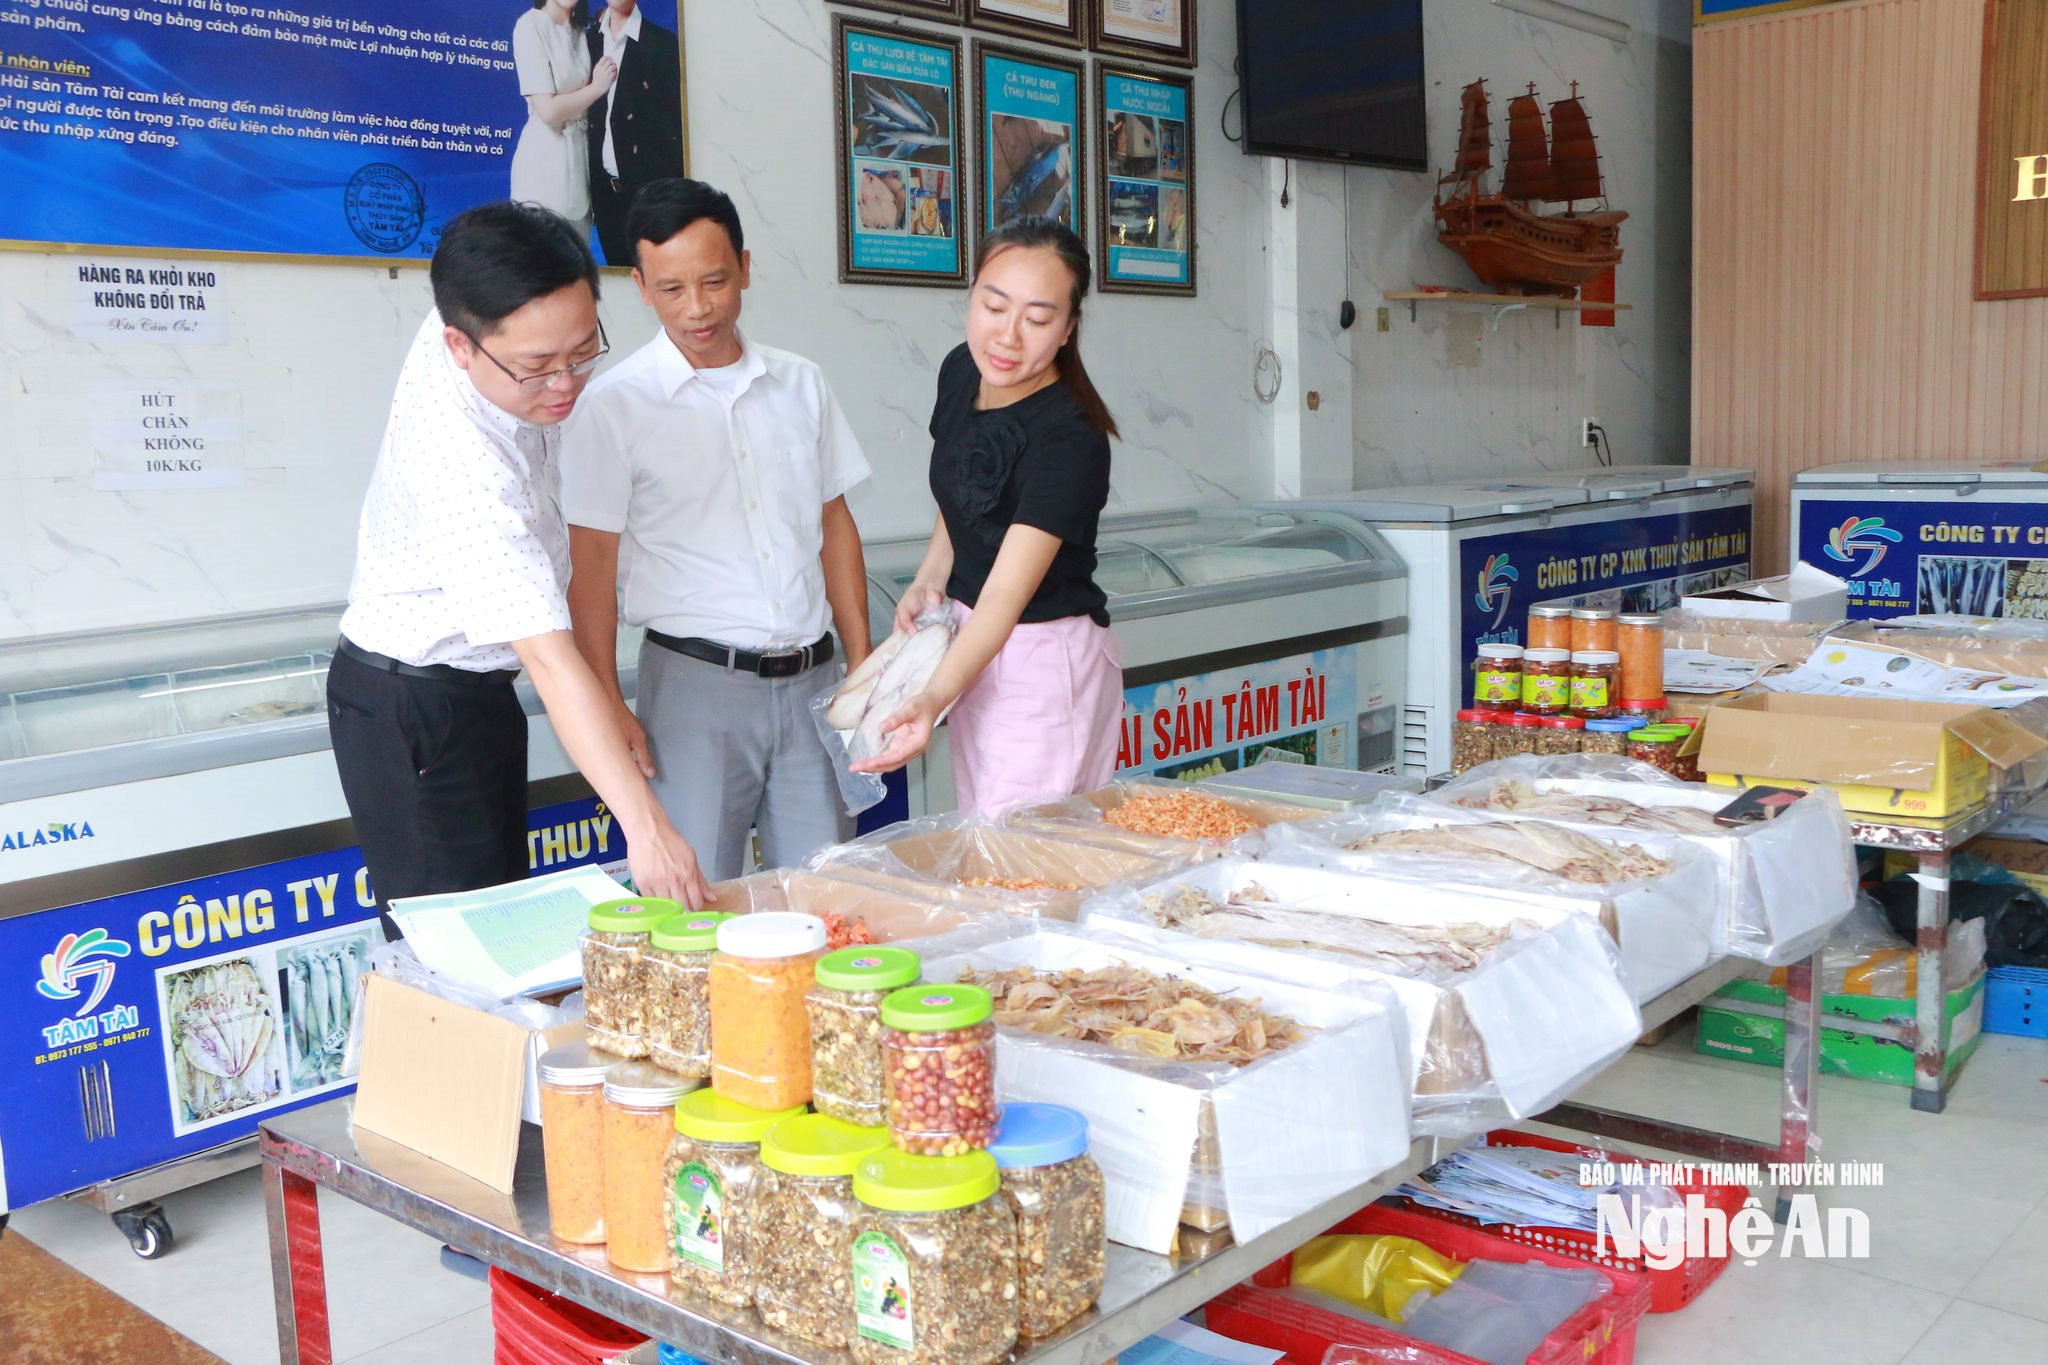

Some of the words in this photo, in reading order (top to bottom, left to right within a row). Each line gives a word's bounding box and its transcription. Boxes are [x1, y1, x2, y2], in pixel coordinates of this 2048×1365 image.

[0, 9, 30, 26] sản
[35, 16, 86, 33] phẩm.
[226, 2, 248, 17] tạo
[252, 8, 264, 18] ra
[268, 9, 309, 26] những
[312, 15, 332, 28] giá
[336, 18, 350, 33] trị
[352, 21, 374, 34] bền
[378, 24, 407, 40] vững
[410, 30, 432, 42] cho
[434, 32, 451, 44] tất
[453, 34, 466, 46] cả
[469, 38, 489, 50] các
[491, 40, 508, 52] đối
[92, 5, 130, 20] cung
[134, 8, 162, 26] ứng
[166, 12, 202, 31] bằng
[206, 22, 238, 34] cách
[242, 24, 272, 38] đảm
[275, 29, 299, 42] bảo
[302, 33, 328, 48] một
[330, 38, 357, 50] mức
[360, 40, 378, 55] Lợi
[380, 42, 418, 59] nhuận
[422, 50, 443, 62] hợp
[446, 51, 456, 64] lý
[458, 54, 490, 69] thông
[493, 60, 514, 70] qua
[8, 54, 50, 70] nhân
[1, 74, 28, 90] Hải
[32, 77, 61, 92] sản
[65, 80, 98, 97] Tâm
[102, 85, 124, 100] Tài
[127, 90, 158, 104] cam
[162, 92, 186, 106] kết
[188, 98, 228, 113] mang
[232, 99, 256, 114] đến
[260, 104, 284, 116] môi
[287, 105, 329, 123] trường
[332, 110, 356, 124] làm
[359, 114, 382, 126] việc
[385, 116, 407, 128] hòa
[410, 118, 440, 134] đồng
[442, 122, 472, 136] tuyệt
[474, 126, 492, 138] vời,
[494, 128, 512, 138] nơi
[16, 98, 62, 114] người
[65, 103, 103, 120] được
[106, 107, 130, 121] tôn
[134, 110, 174, 126] trọng
[208, 117, 237, 131] điều
[240, 120, 268, 136] kiện
[271, 124, 294, 136] cho
[298, 126, 330, 140] nhân
[333, 129, 358, 142] viên
[361, 131, 388, 146] phát
[392, 134, 418, 148] triển
[422, 138, 443, 150] bản
[446, 140, 472, 153] thân
[475, 143, 488, 154] và
[490, 144, 504, 155] có
[23, 119, 50, 134] thu
[54, 124, 94, 140] nhập
[98, 127, 135, 144] xứng
[138, 131, 180, 148] đáng.
[79, 264, 120, 284] HÀNG
[126, 268, 145, 284] RA
[149, 265, 182, 286] KHỎI
[187, 271, 216, 288] KHO
[94, 289, 146, 309] KHÔNG
[150, 288, 175, 310] ĐỔI
[178, 290, 206, 311] TRẢ
[142, 391, 176, 407] HÚT
[142, 412, 190, 429] CHÂN
[144, 434, 204, 451] KHÔNG
[146, 459, 202, 472] 10K/KG
[1919, 521, 1984, 544] CÔNG
[1992, 526, 2021, 544] TY
[1537, 556, 1577, 590] CÔNG
[1580, 555, 1597, 582] TY
[1600, 553, 1618, 580] CP
[1621, 548, 1648, 576] XNK
[1681, 533, 1704, 564] SẢN
[1706, 532, 1728, 560] TÂM
[1730, 529, 1747, 556] TÀI
[1869, 578, 1900, 598] TÀI
[1153, 686, 1213, 760] SẢN
[1222, 680, 1280, 744] TÂM
[1288, 668, 1326, 727] TÀI
[1904, 800, 1926, 810] 999
[0, 821, 95, 852] ALASKA
[138, 888, 276, 957] CÔNG
[286, 872, 340, 924] TY
[42, 1017, 99, 1048] TÂM
[99, 1004, 139, 1034] TÀI
[68, 1046, 82, 1056] 177
[137, 1028, 150, 1039] 777
